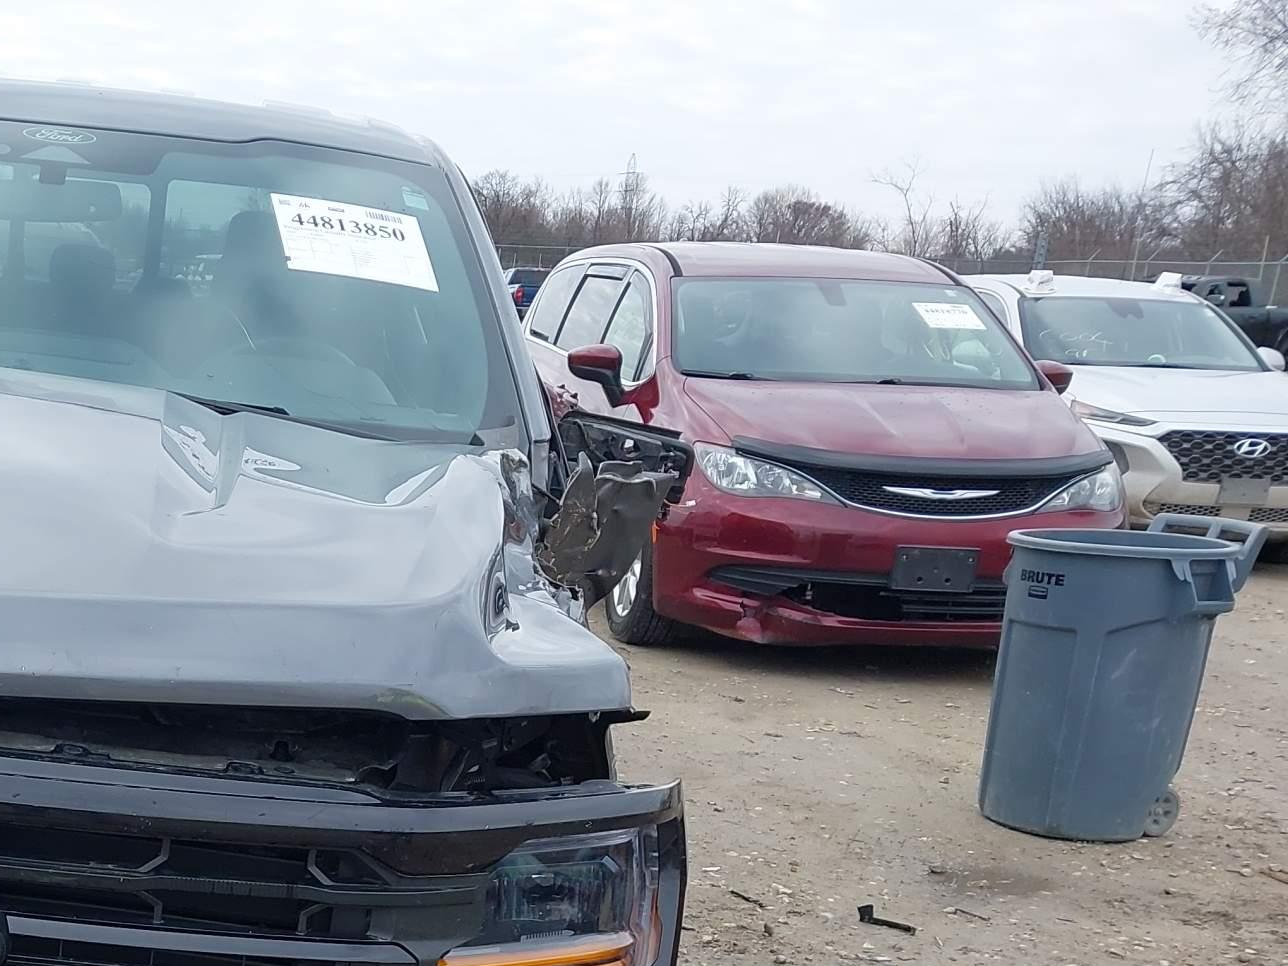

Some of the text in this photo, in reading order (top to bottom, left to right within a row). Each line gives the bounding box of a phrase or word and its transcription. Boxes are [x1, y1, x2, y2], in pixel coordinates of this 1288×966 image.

[35, 128, 85, 141] Ford
[291, 212, 406, 242] 44813850
[1021, 569, 1065, 586] BRUTE
